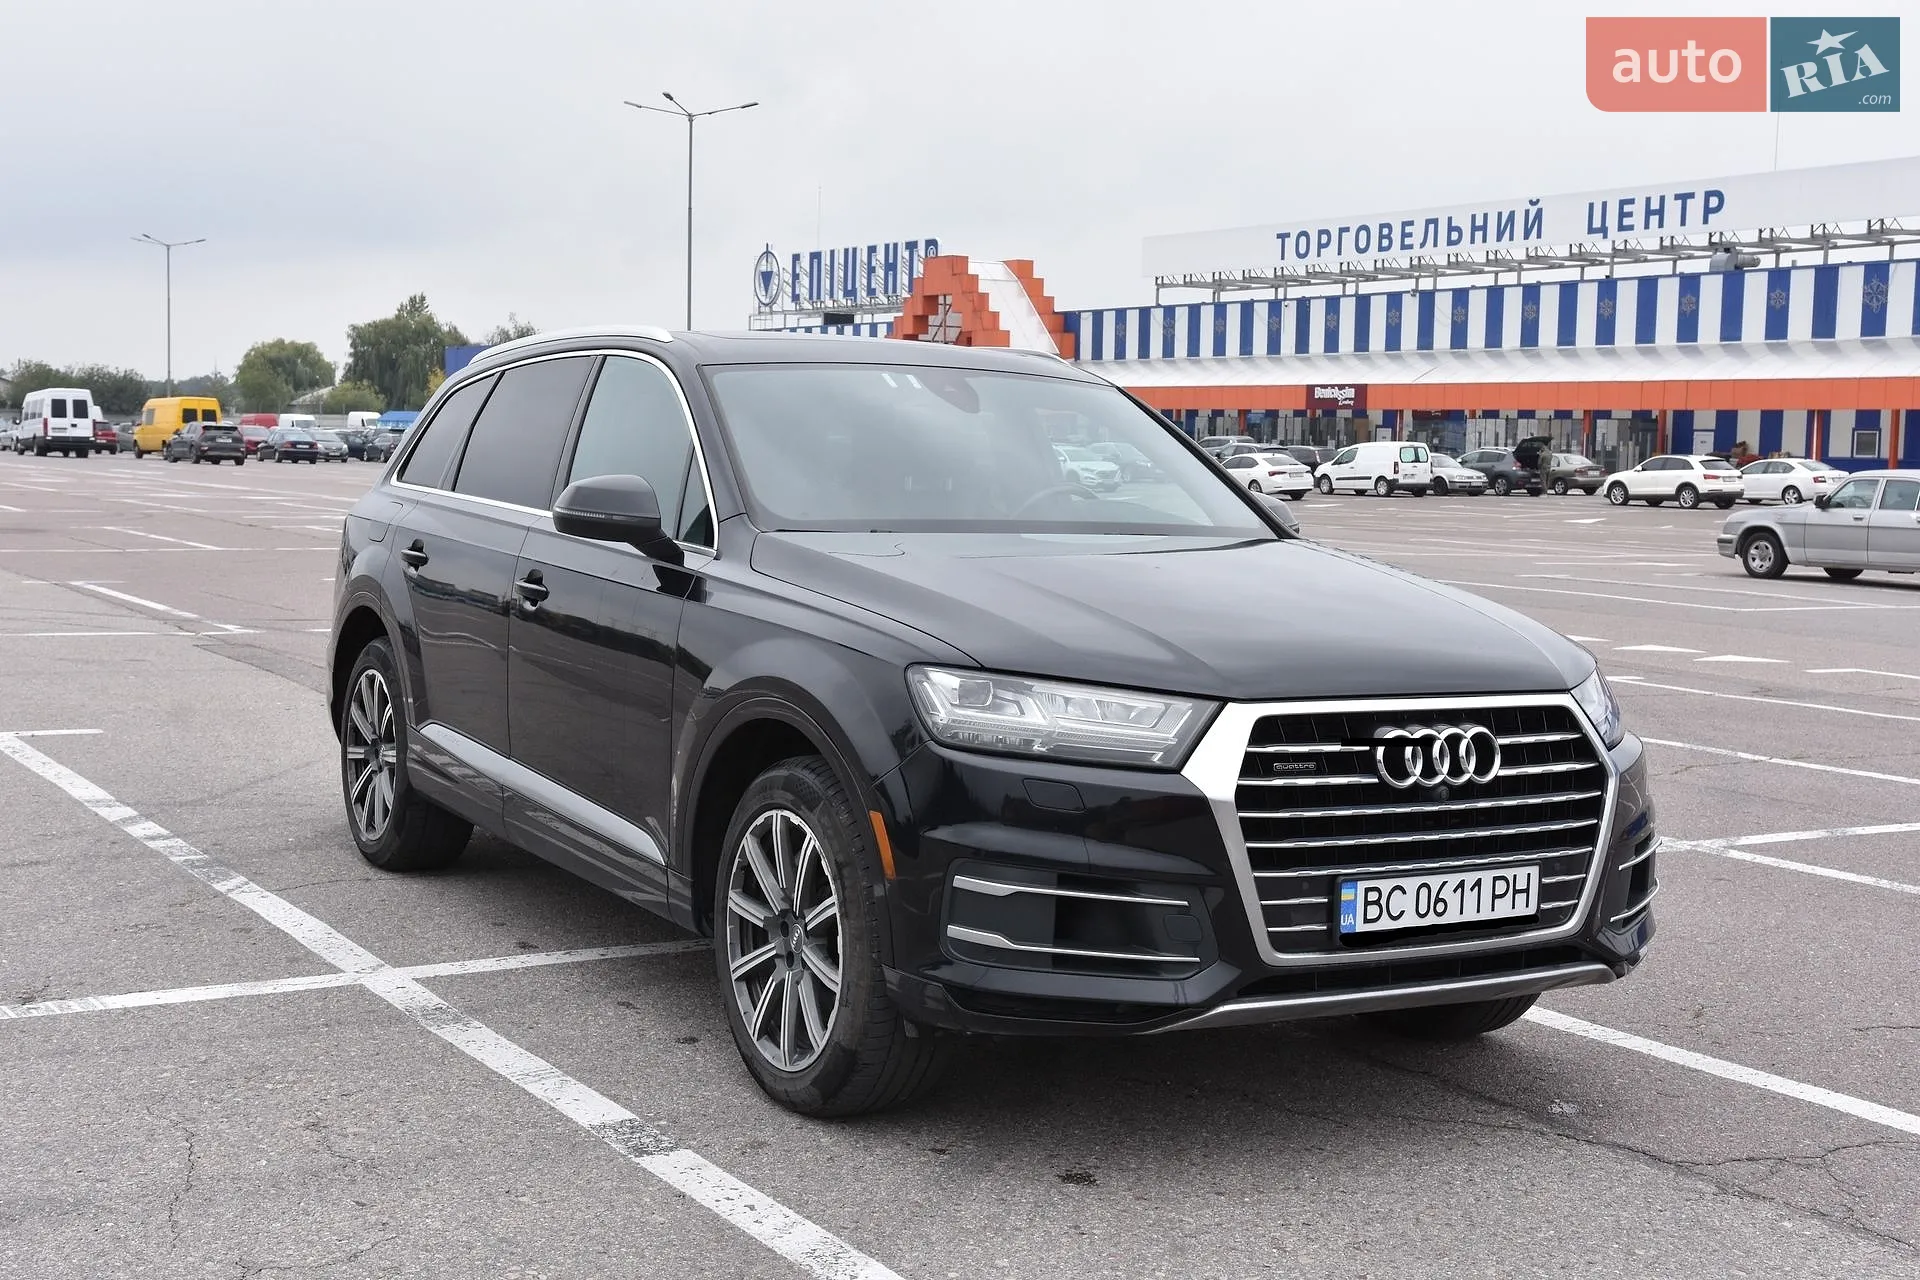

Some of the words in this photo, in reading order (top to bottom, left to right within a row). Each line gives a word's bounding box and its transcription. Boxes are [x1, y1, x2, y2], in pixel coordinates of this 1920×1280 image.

[1276, 198, 1543, 260] ТОРГОВЕЛЬНИЙ
[1586, 189, 1726, 240] ЦЕНТР
[1341, 913, 1354, 925] UA
[1363, 885, 1407, 924] BC
[1415, 877, 1482, 918] 0611
[1491, 872, 1531, 912] PH
